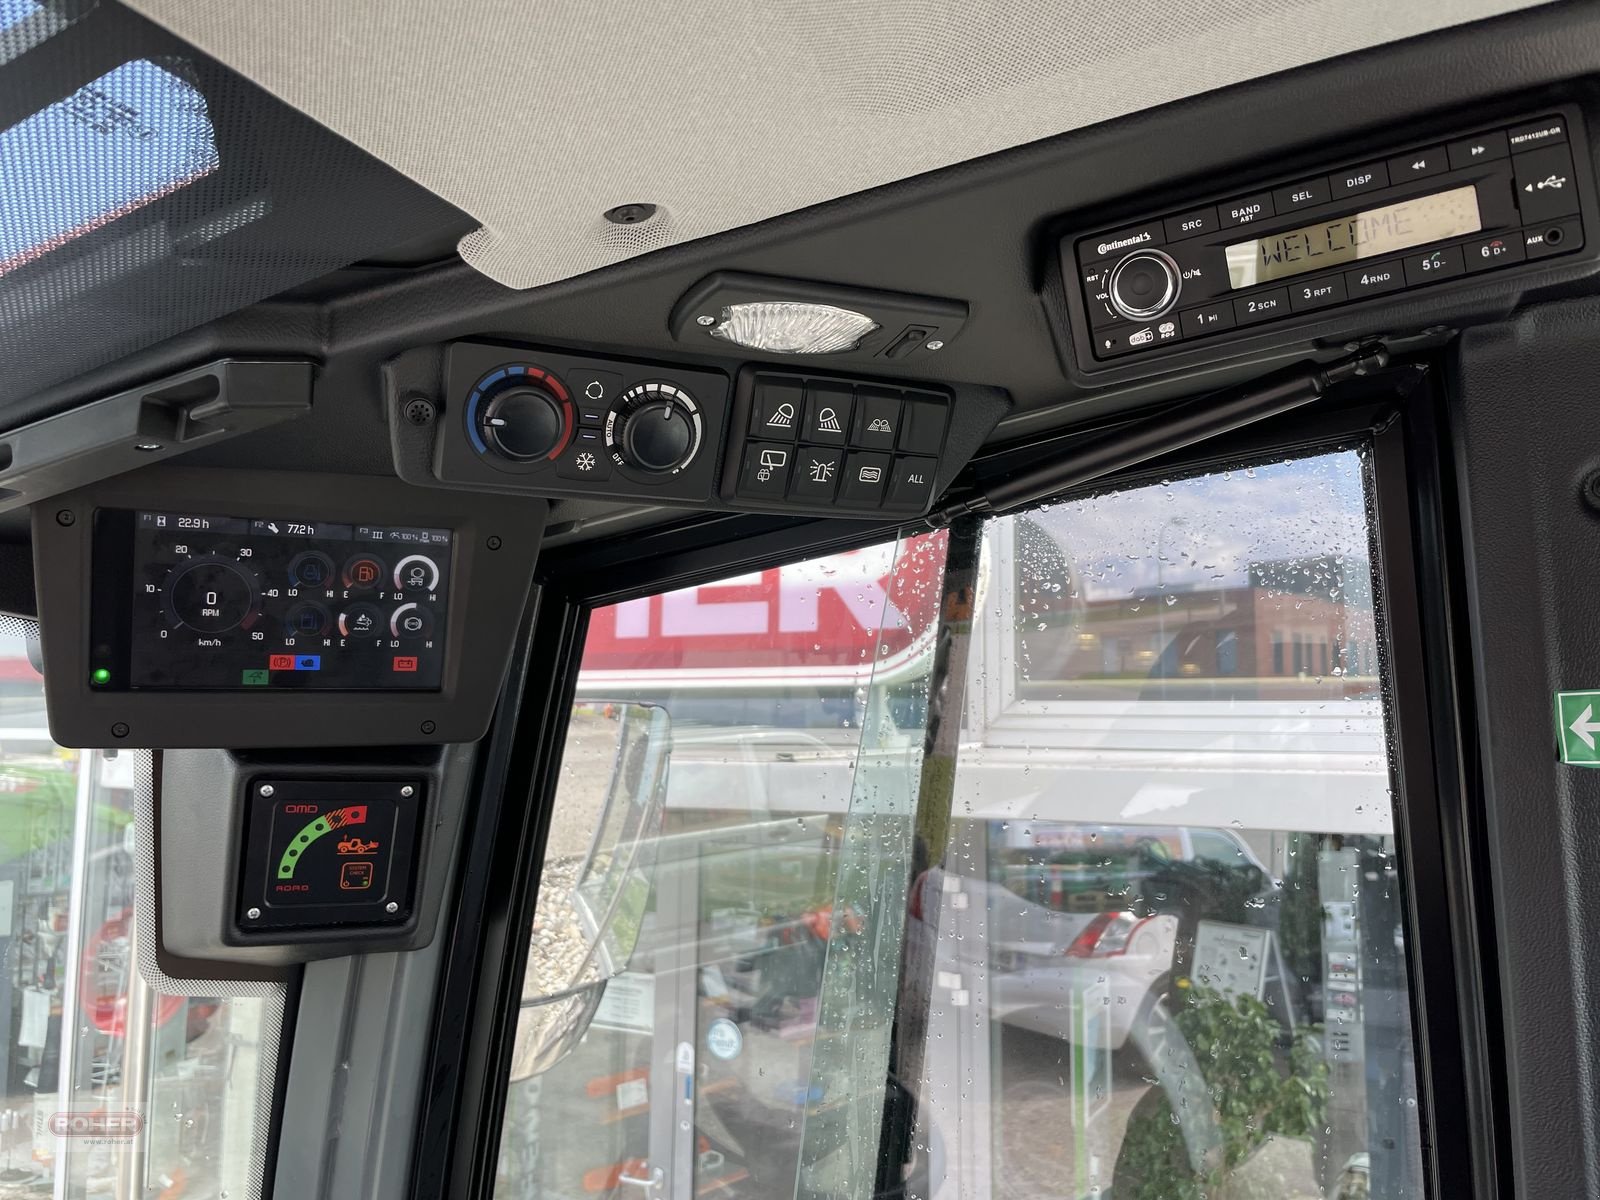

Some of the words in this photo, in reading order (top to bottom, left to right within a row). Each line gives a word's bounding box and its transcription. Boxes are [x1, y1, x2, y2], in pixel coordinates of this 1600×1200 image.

[1346, 174, 1372, 187] DISP
[1291, 190, 1313, 202] SEL
[1231, 204, 1261, 218] BAND
[1240, 214, 1254, 223] AST
[1181, 219, 1203, 231] SRC
[1261, 207, 1413, 267] WELCOME
[1526, 234, 1544, 245] AUX
[1097, 233, 1144, 255] Continental
[1481, 246, 1490, 257] 6
[1422, 259, 1431, 271] 5
[1086, 274, 1099, 282] RST
[1360, 274, 1370, 285] 4
[1370, 273, 1391, 284] RND
[1095, 292, 1110, 301] VOL
[1303, 288, 1312, 299] 3
[1313, 286, 1332, 297] RPT
[1248, 301, 1257, 313] 2
[1258, 300, 1277, 310] SCN
[1197, 313, 1204, 324] 1
[612, 452, 625, 466] OFF
[907, 474, 924, 484] ALL
[178, 517, 201, 529] 22.9
[202, 519, 210, 529] h
[287, 523, 306, 535] 77.2
[307, 525, 314, 535] h
[175, 545, 188, 554] 20
[240, 548, 252, 557] 30
[145, 584, 155, 593] 10
[267, 589, 279, 597] 40
[288, 588, 298, 597] LO
[206, 591, 217, 605] 0
[326, 590, 334, 598] HI
[343, 591, 349, 599] E
[379, 592, 385, 600] F
[202, 609, 220, 617] RPM
[160, 630, 168, 638] 0
[251, 632, 264, 640] 50
[198, 638, 221, 647] km/h
[285, 638, 295, 646] LO
[323, 639, 331, 647] HI
[340, 639, 346, 647] E
[390, 640, 400, 648] LO
